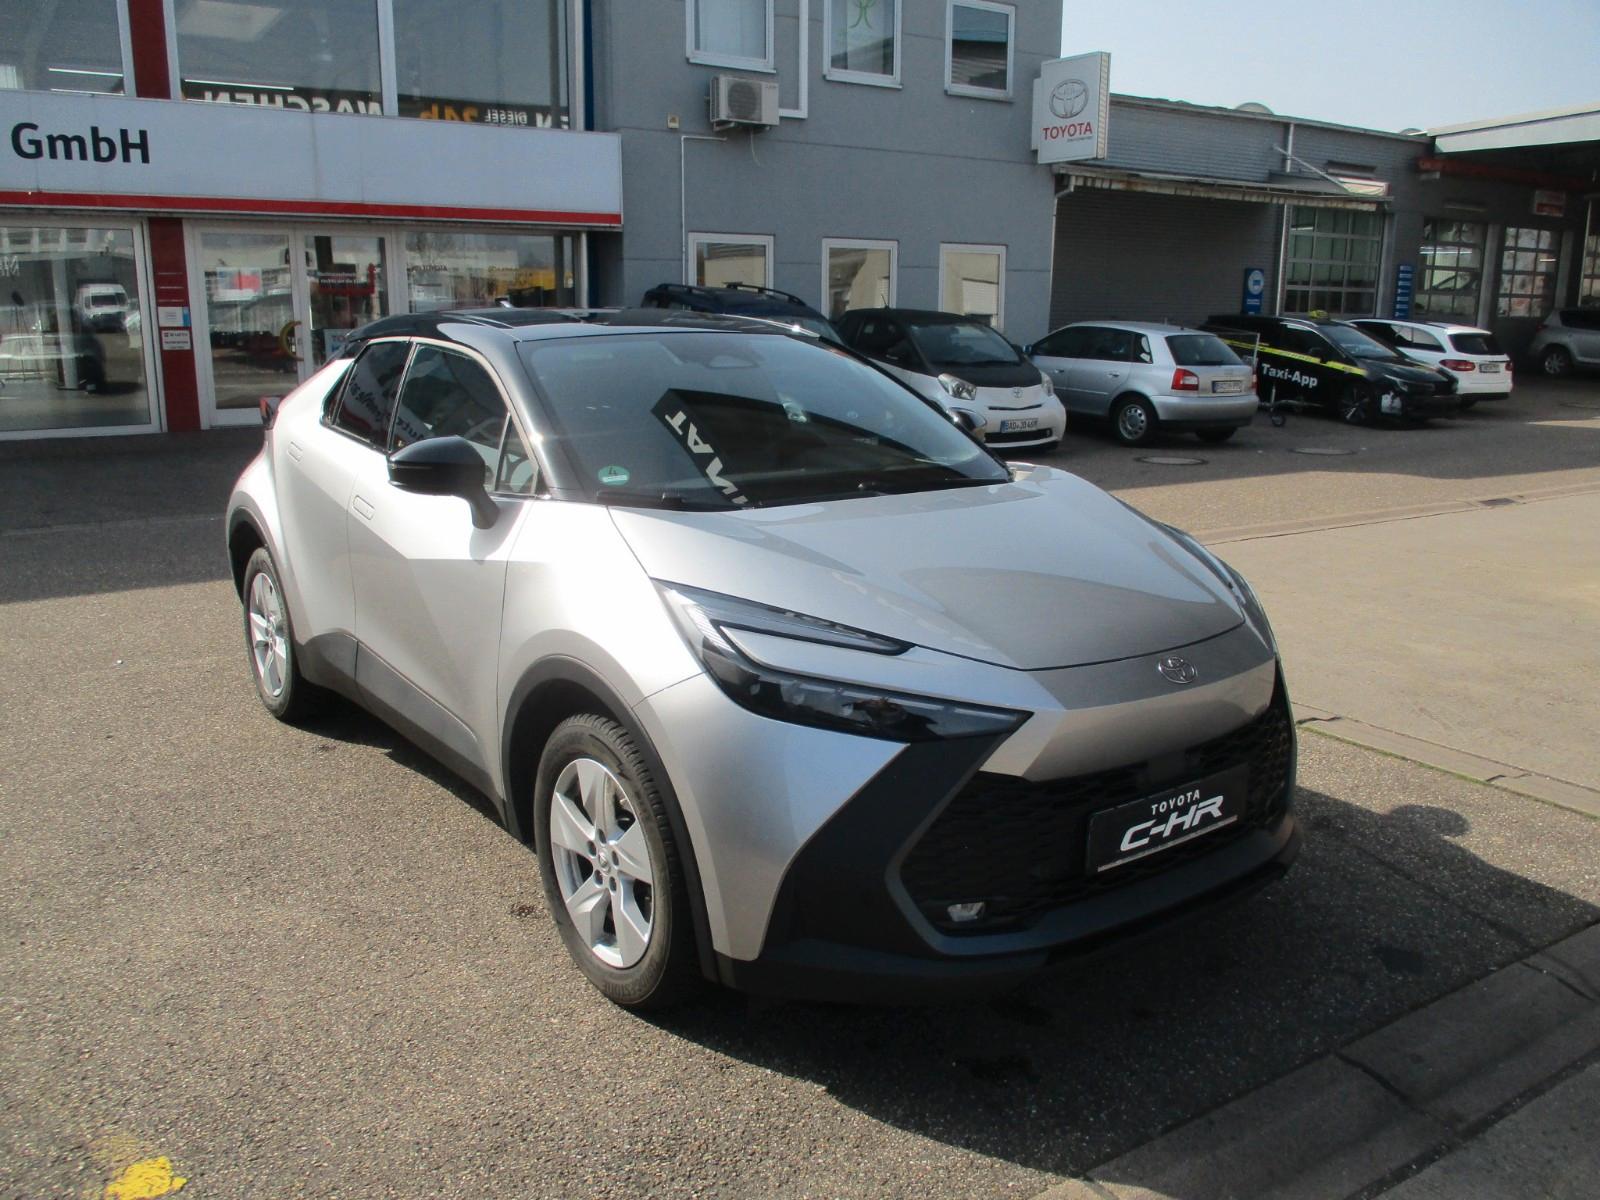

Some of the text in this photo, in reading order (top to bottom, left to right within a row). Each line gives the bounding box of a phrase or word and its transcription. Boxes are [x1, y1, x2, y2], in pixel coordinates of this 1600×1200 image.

[11, 122, 150, 164] GmbH
[1042, 121, 1093, 140] TOYOTA
[1261, 363, 1318, 388] Taxi-App
[1151, 789, 1200, 815] TOYOTA
[1120, 795, 1224, 851] C-HR
